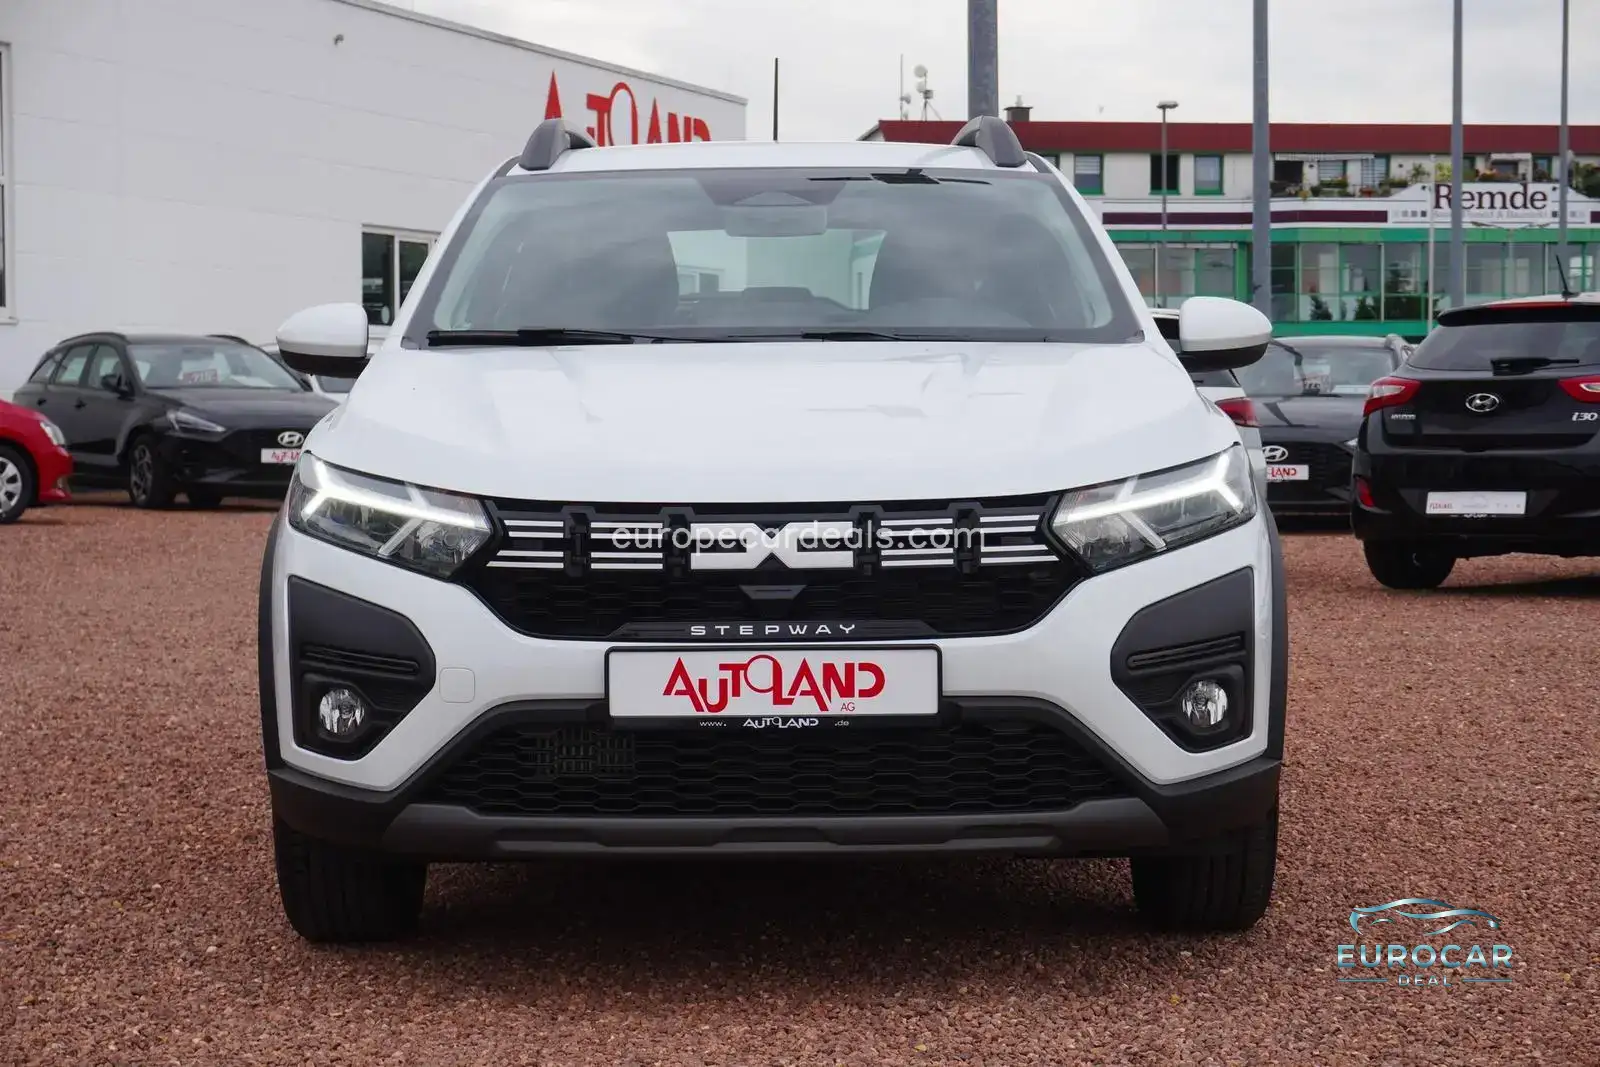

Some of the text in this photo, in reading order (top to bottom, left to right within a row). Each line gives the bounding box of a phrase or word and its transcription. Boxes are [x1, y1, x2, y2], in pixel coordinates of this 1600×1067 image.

[1434, 181, 1548, 210] Remde
[1571, 412, 1598, 421] i30
[691, 624, 855, 636] STEPWAY
[663, 654, 886, 713] AUTOLAND
[840, 701, 856, 712] AG
[743, 716, 819, 729] AUTOLAND
